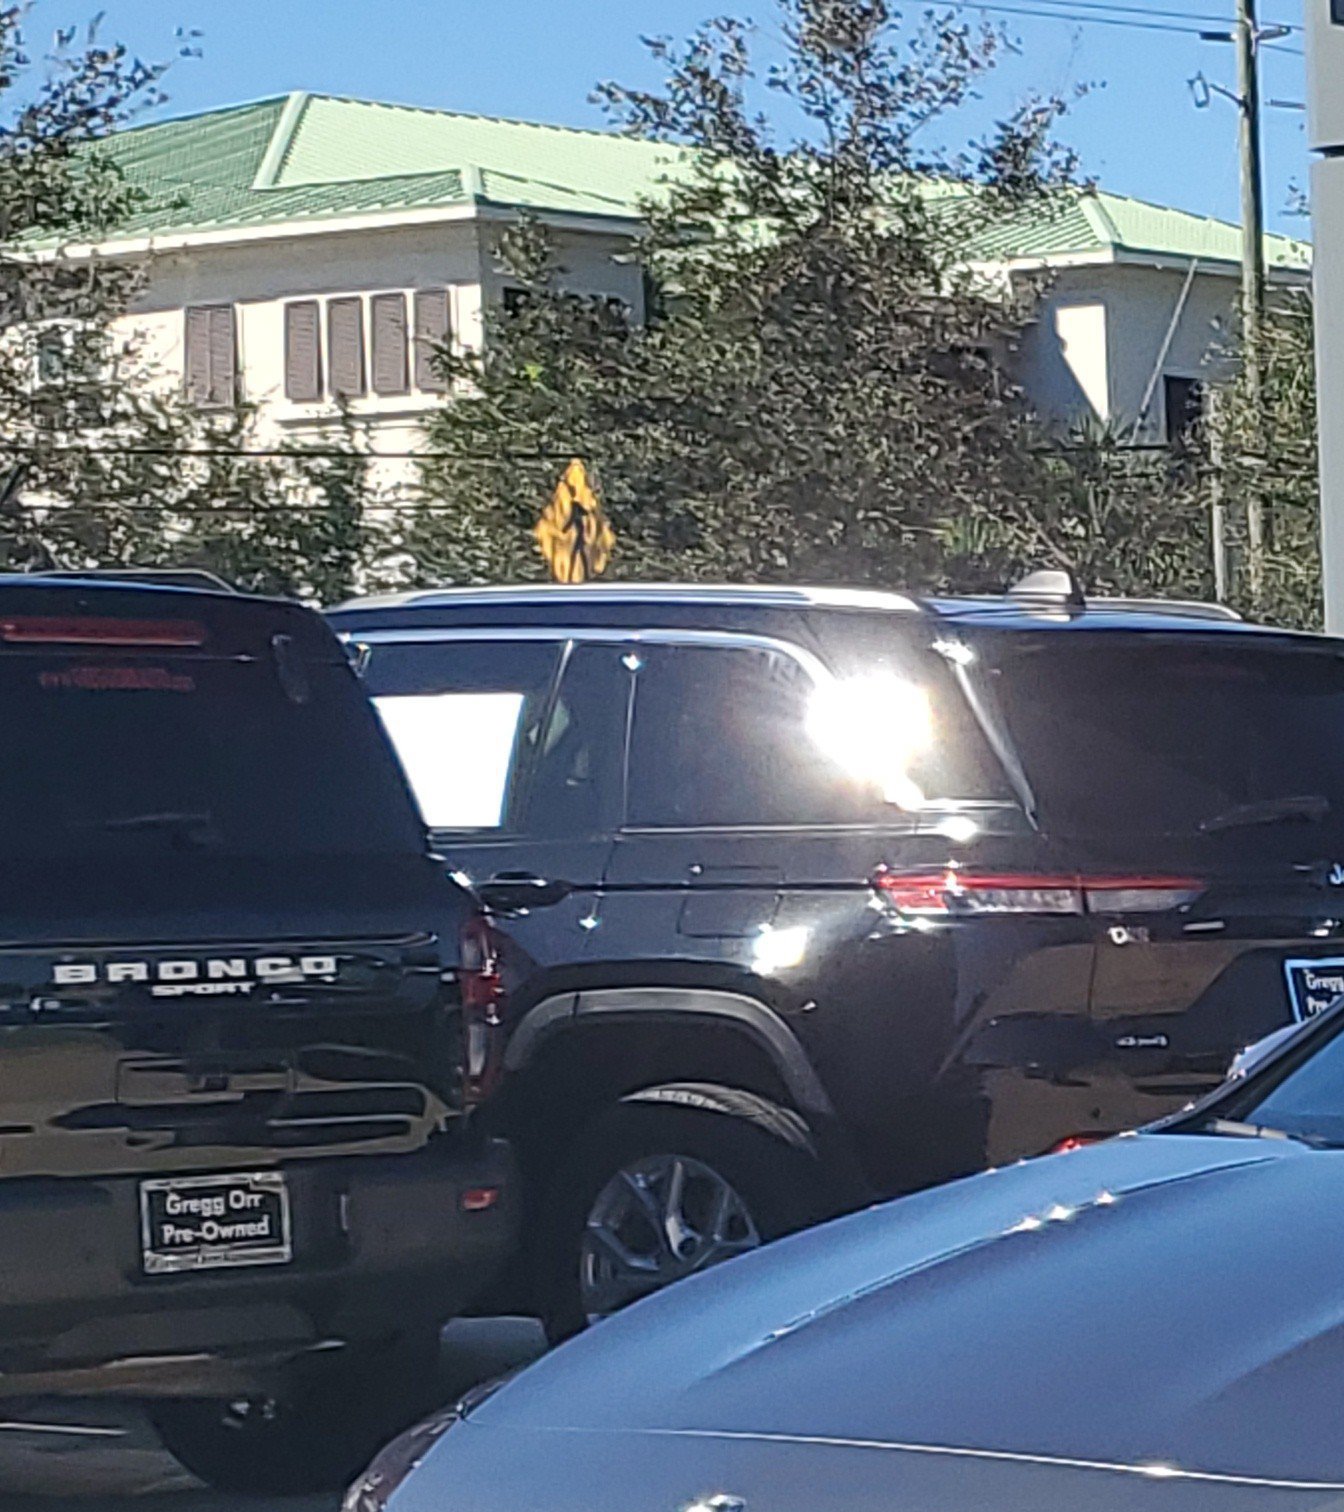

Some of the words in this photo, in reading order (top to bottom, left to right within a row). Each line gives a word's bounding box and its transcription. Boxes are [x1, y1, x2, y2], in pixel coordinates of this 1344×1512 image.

[53, 955, 337, 984] BRONCO
[151, 981, 256, 996] SPORT
[165, 1192, 226, 1217] Gregg
[229, 1189, 263, 1209] Orr
[161, 1214, 270, 1245] Pre-Owned
